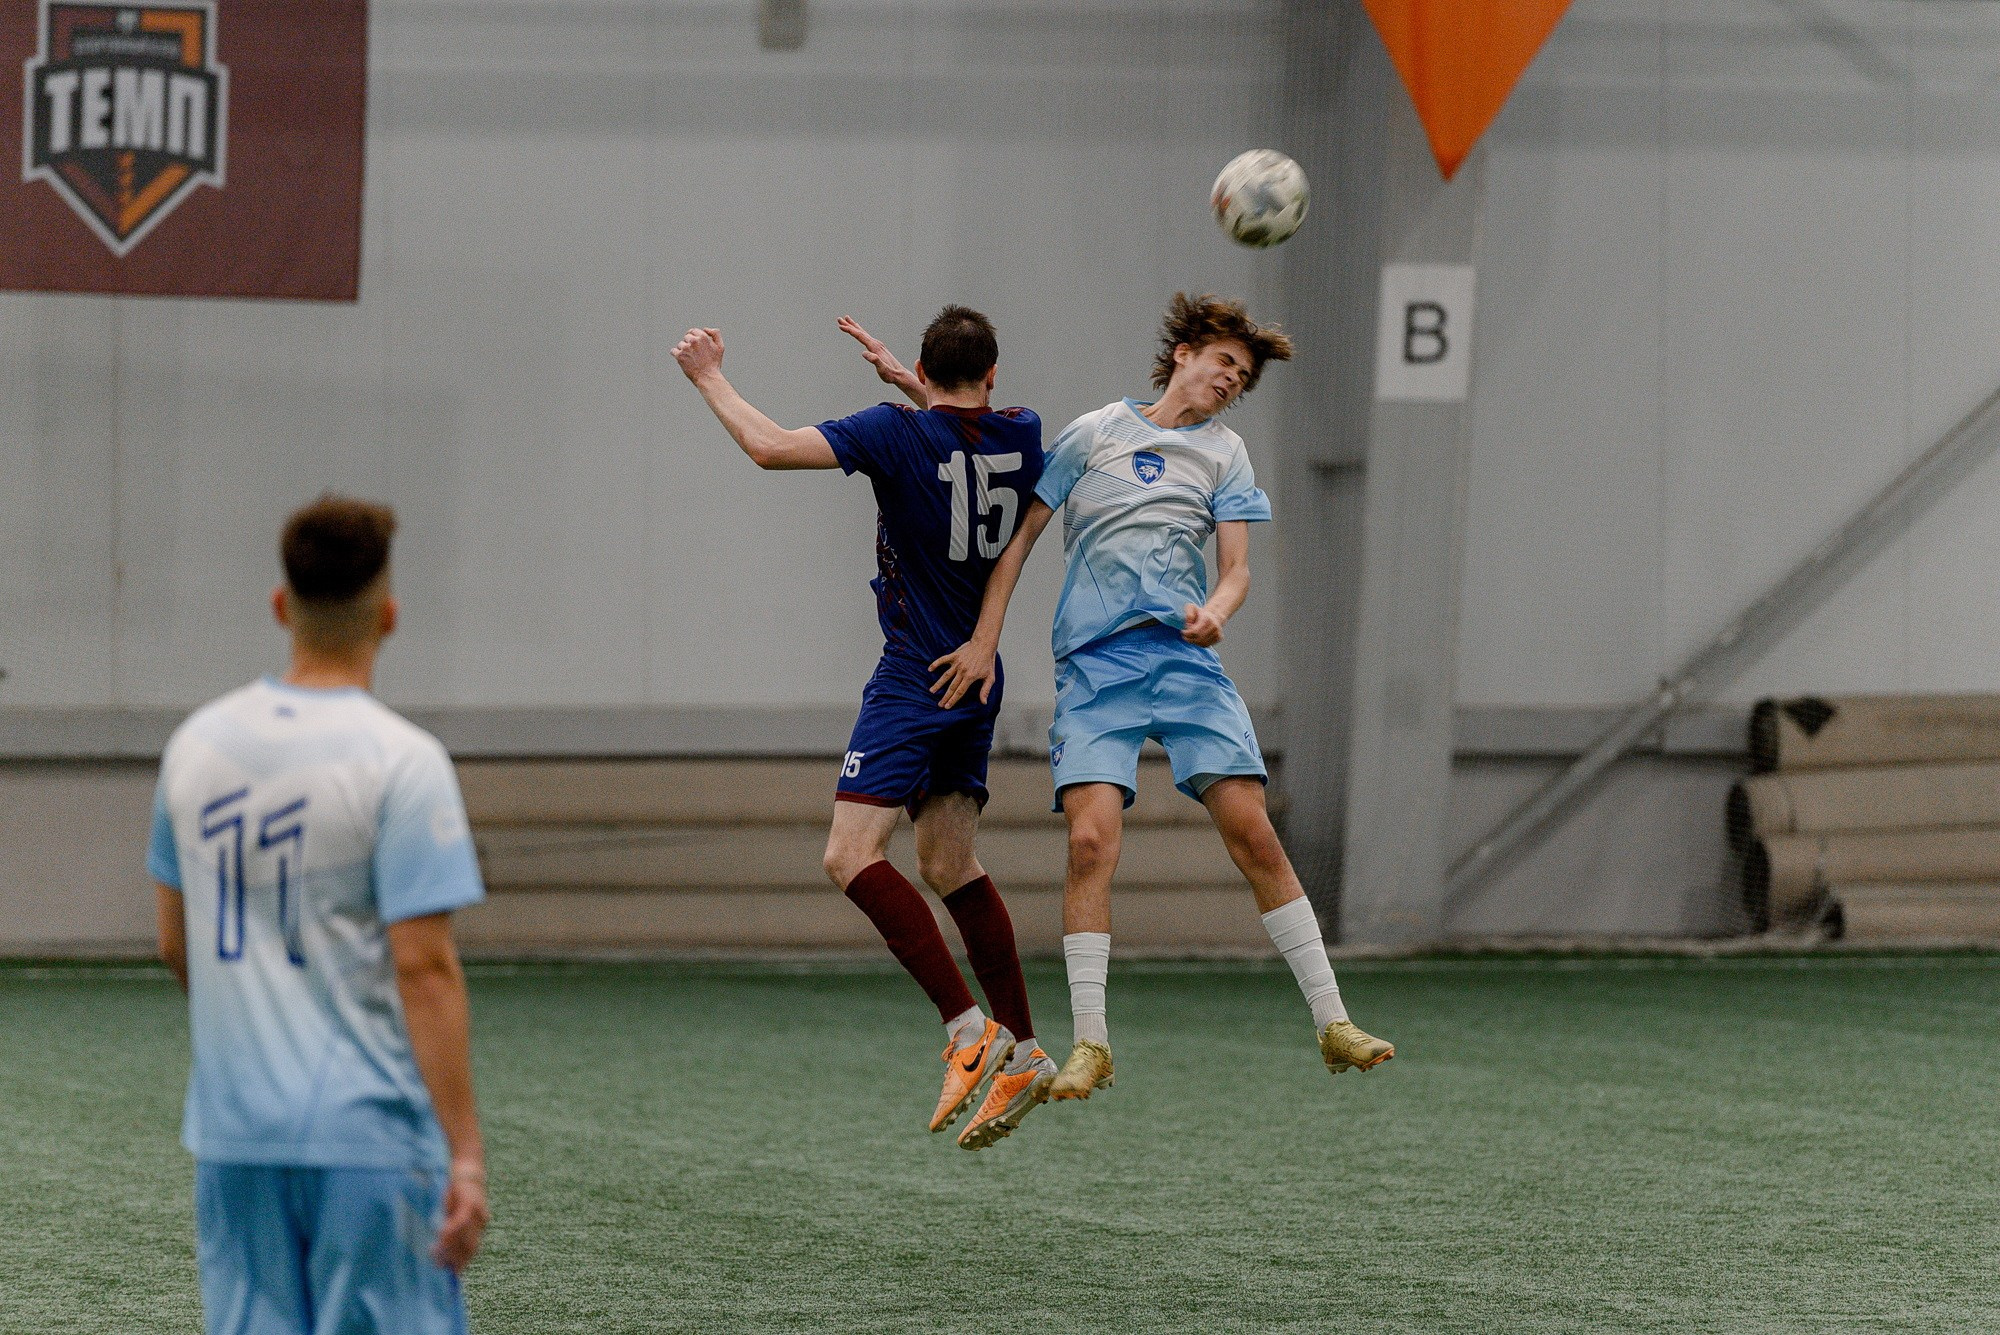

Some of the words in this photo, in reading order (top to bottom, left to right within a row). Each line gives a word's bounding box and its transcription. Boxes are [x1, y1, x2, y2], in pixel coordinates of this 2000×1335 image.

[45, 66, 207, 159] ТЕМП
[937, 450, 1022, 561] 15
[840, 750, 865, 778] 15
[200, 786, 308, 967] 11
